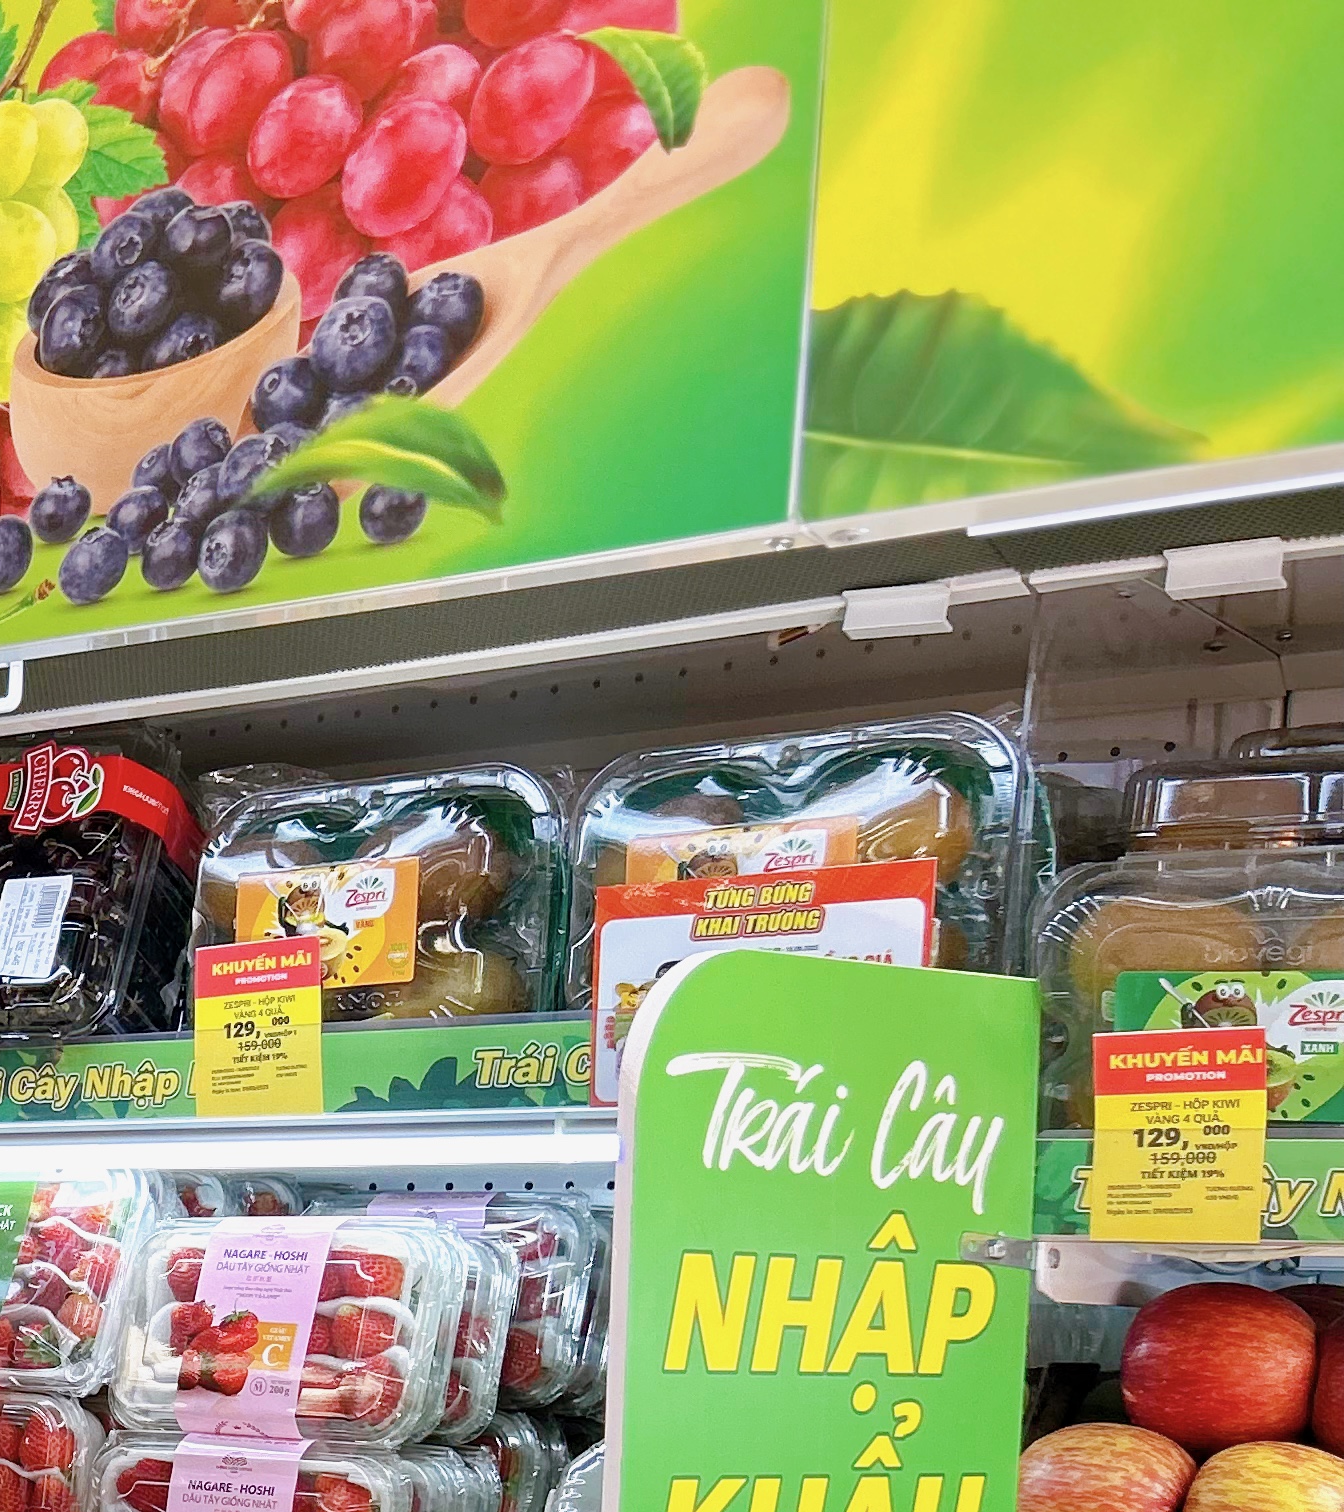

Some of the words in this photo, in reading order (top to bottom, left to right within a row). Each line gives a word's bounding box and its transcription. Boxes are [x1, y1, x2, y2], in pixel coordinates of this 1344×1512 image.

[25, 752, 51, 823] CHERRY
[764, 853, 816, 872] Zespri
[345, 887, 387, 906] Zespri
[694, 914, 741, 937] KHAI
[744, 908, 821, 934] TRƯƠNG
[211, 952, 277, 977] KHUYẾN
[280, 950, 312, 969] MÃI
[471, 1040, 559, 1089] Trái
[1109, 1045, 1209, 1070] KHUYẾN
[1215, 1044, 1263, 1065] MÃI
[9, 1065, 82, 1109] Cây
[83, 1063, 189, 1115] Nhập
[1145, 1071, 1227, 1082] PROMOTION
[1212, 1099, 1240, 1109] KIWI
[665, 1049, 859, 1178] Trái
[870, 1072, 1007, 1216] Cây
[1133, 1127, 1189, 1150] 129,
[1203, 1125, 1231, 1136] 000
[223, 1249, 267, 1259] NAGARE
[274, 1251, 308, 1262] HOSHI
[661, 1209, 998, 1415] NHẬP
[262, 1344, 284, 1367] C
[187, 1480, 233, 1493] NAGARE
[239, 1485, 275, 1497] HOSHI
